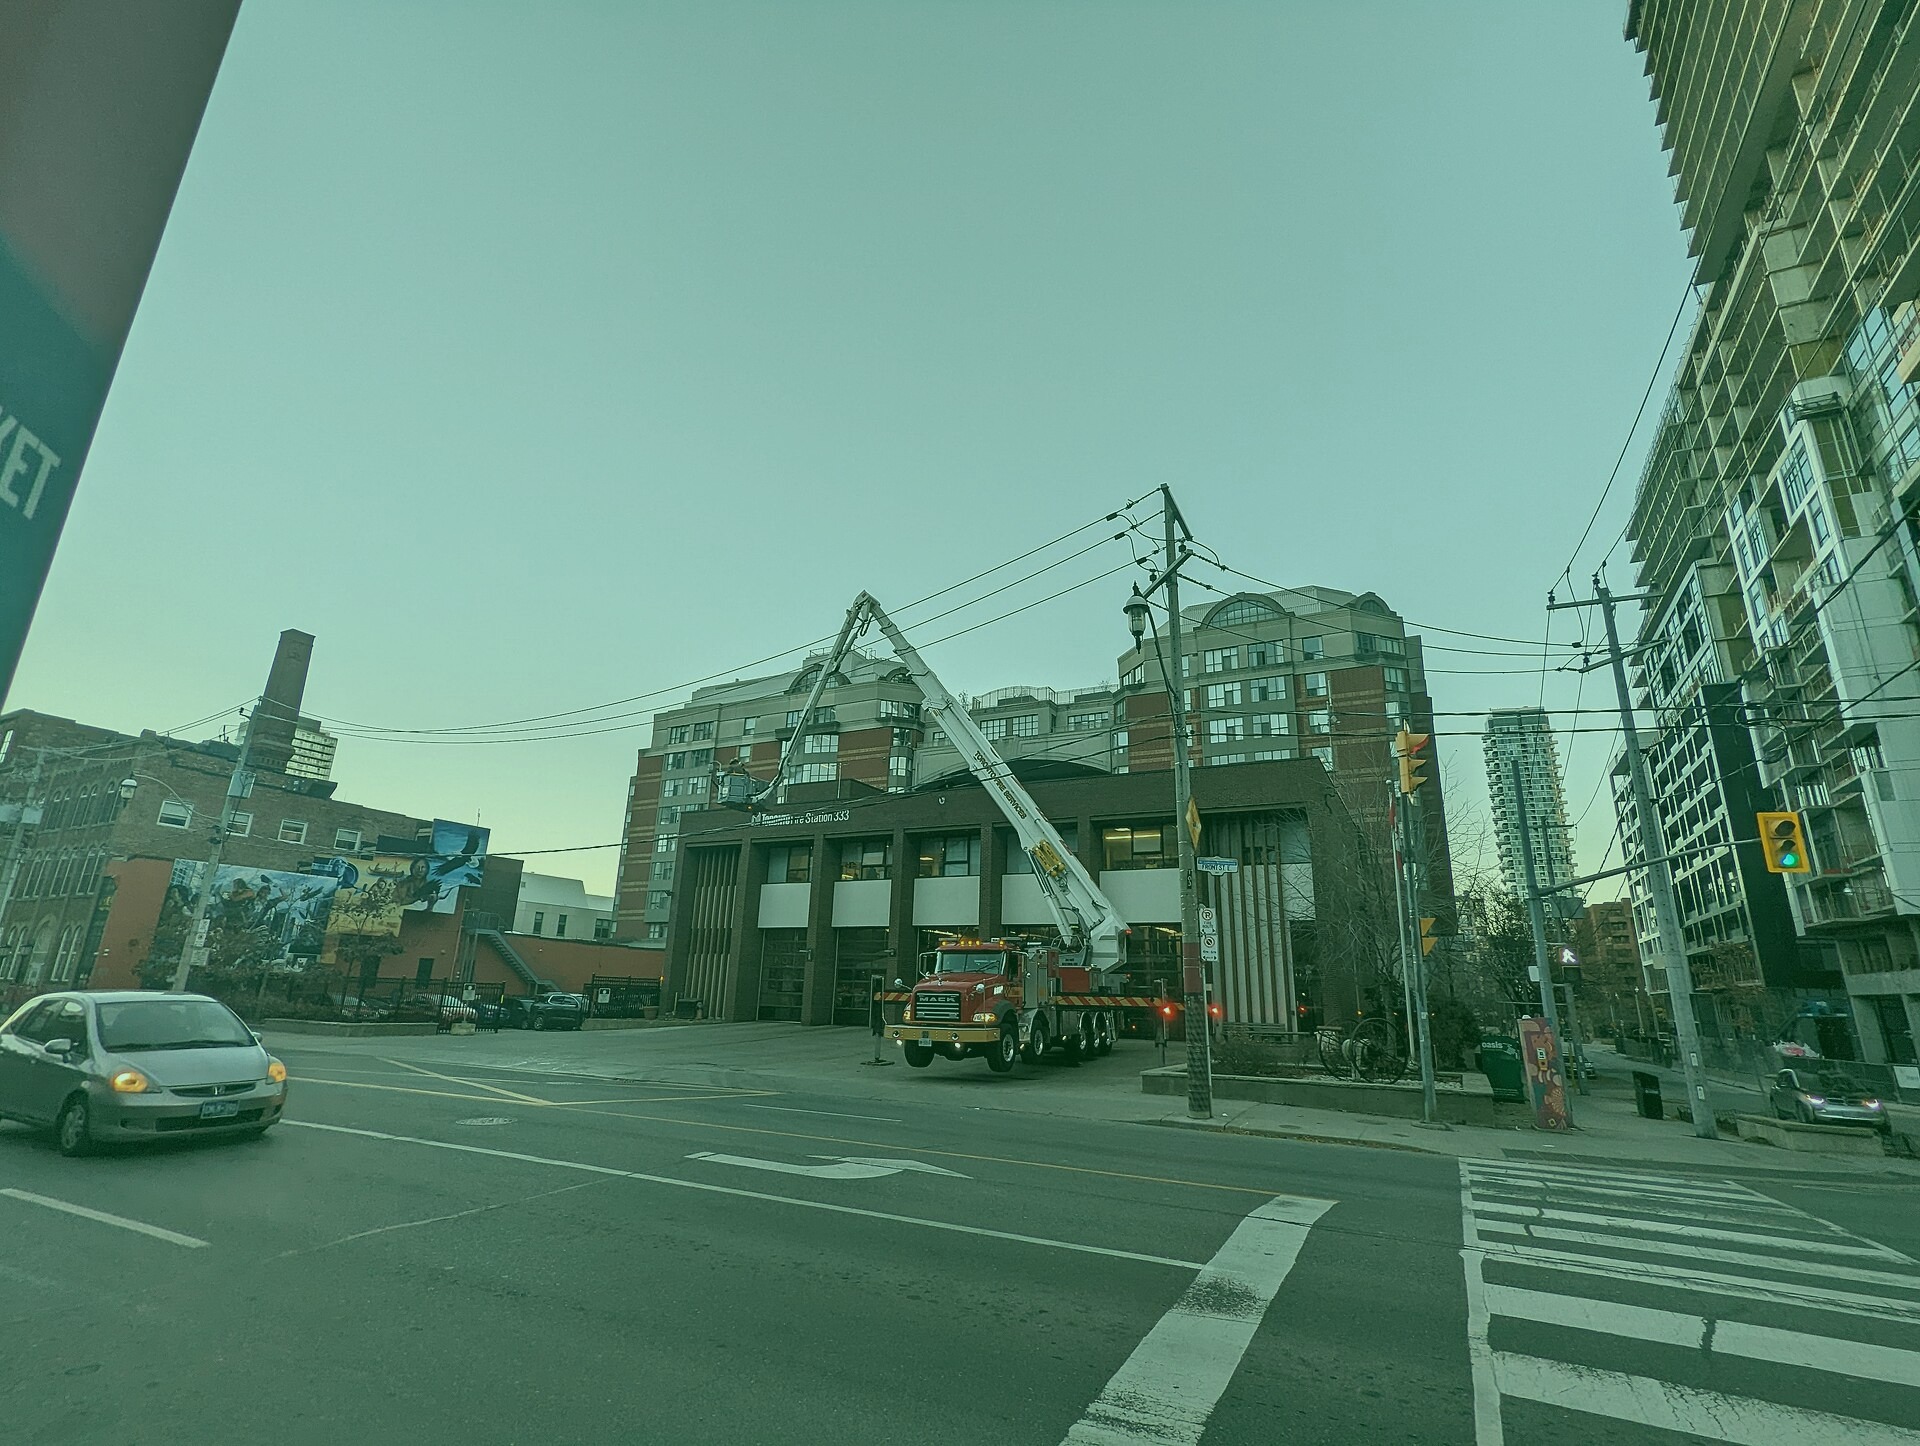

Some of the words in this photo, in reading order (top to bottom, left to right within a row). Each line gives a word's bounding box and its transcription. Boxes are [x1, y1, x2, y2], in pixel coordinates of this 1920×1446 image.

[1003, 790, 1028, 820] SERVICES
[805, 812, 833, 824] Station
[833, 809, 850, 821] 333
[1481, 1041, 1504, 1049] oasis
